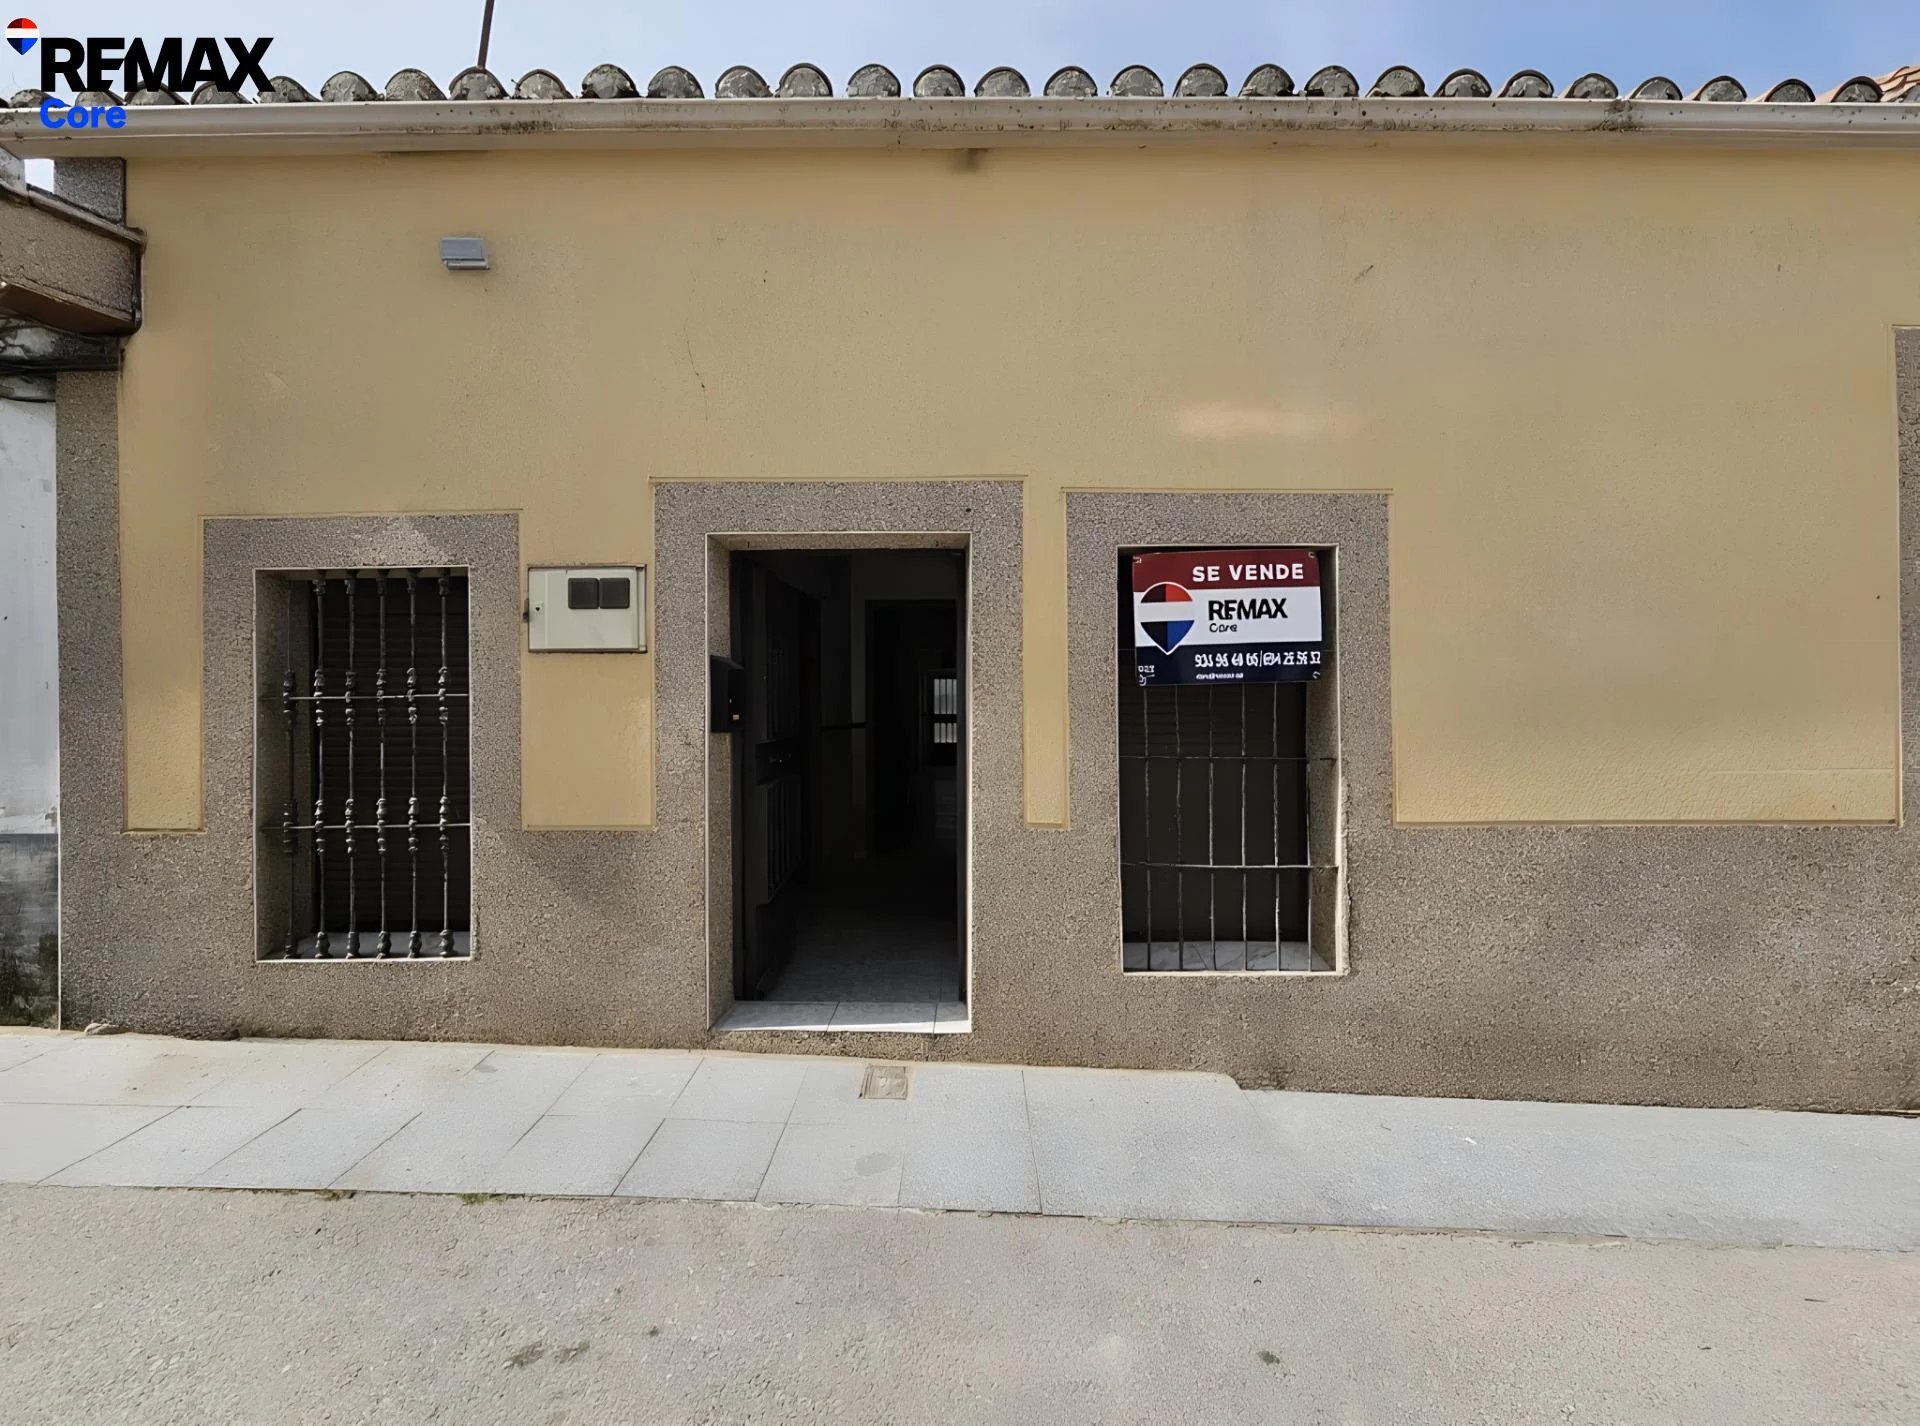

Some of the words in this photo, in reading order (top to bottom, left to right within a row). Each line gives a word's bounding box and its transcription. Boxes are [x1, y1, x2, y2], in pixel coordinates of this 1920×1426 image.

[1192, 565, 1220, 582] SE
[1229, 563, 1304, 581] VENDE
[1208, 598, 1289, 621] REMAX
